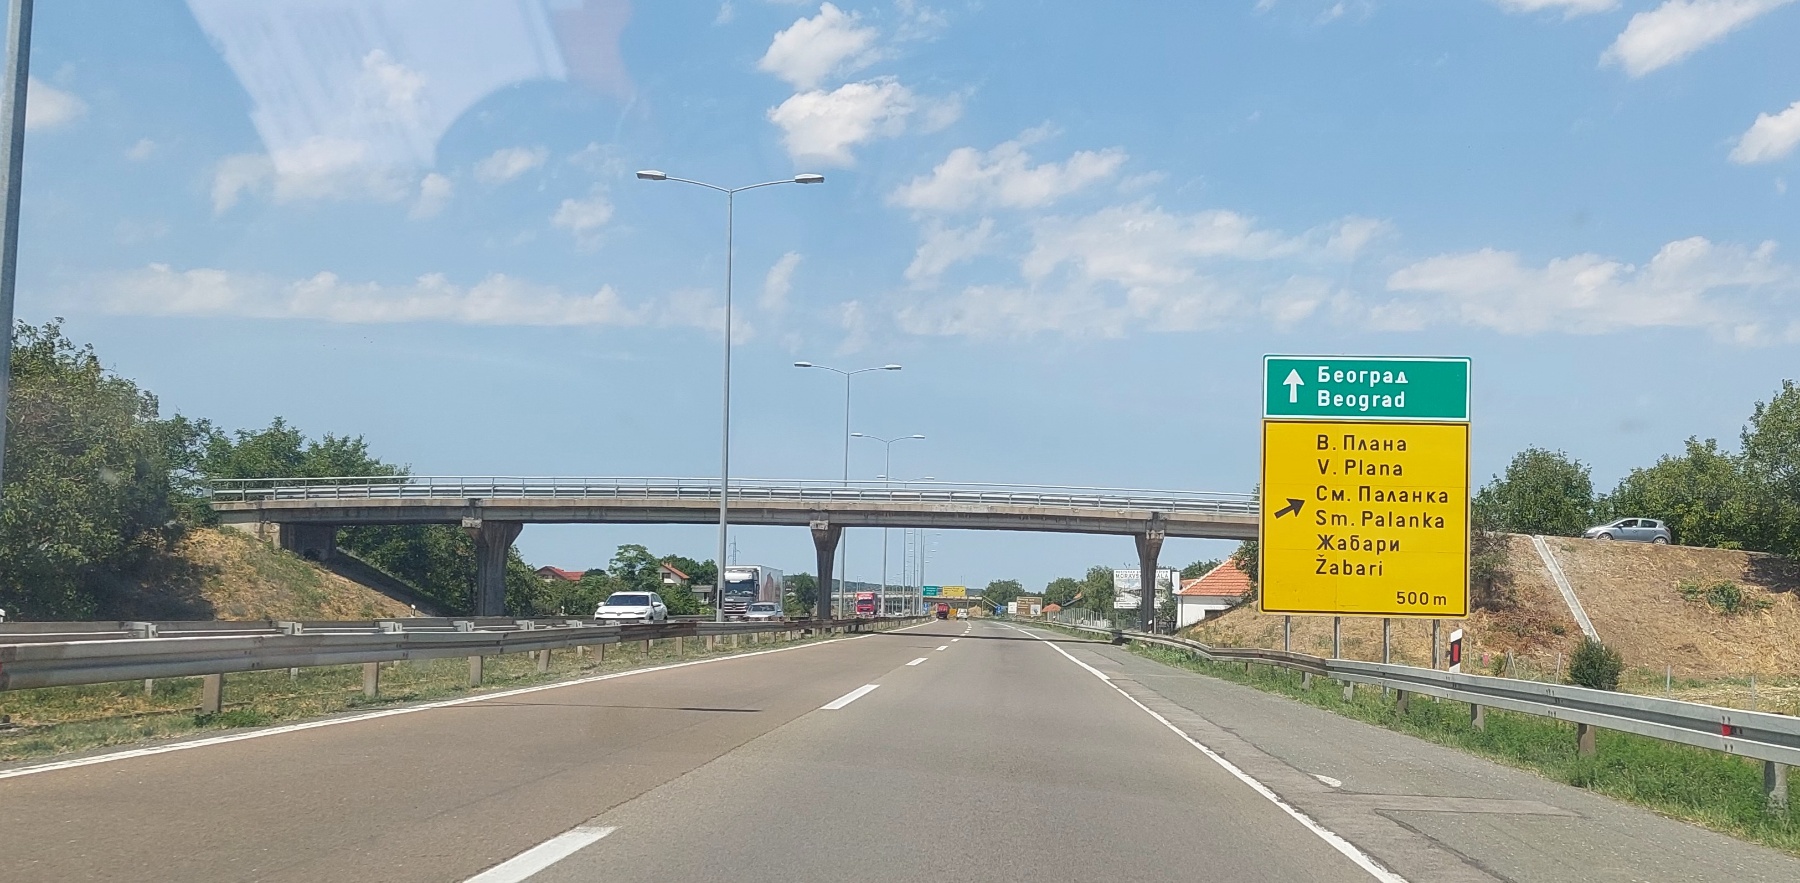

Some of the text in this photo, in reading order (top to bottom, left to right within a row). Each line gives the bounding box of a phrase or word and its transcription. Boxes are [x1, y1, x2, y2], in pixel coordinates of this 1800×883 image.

[1318, 366, 1408, 387] Београд
[1318, 390, 1405, 411] Beograd
[1344, 435, 1406, 451] Плана
[1318, 459, 1402, 476] V. Plana
[1316, 486, 1447, 503] См. Паланка
[1316, 510, 1444, 528] Sm. Palanka
[1317, 534, 1399, 555] Жабари
[1316, 554, 1382, 576] Žabari
